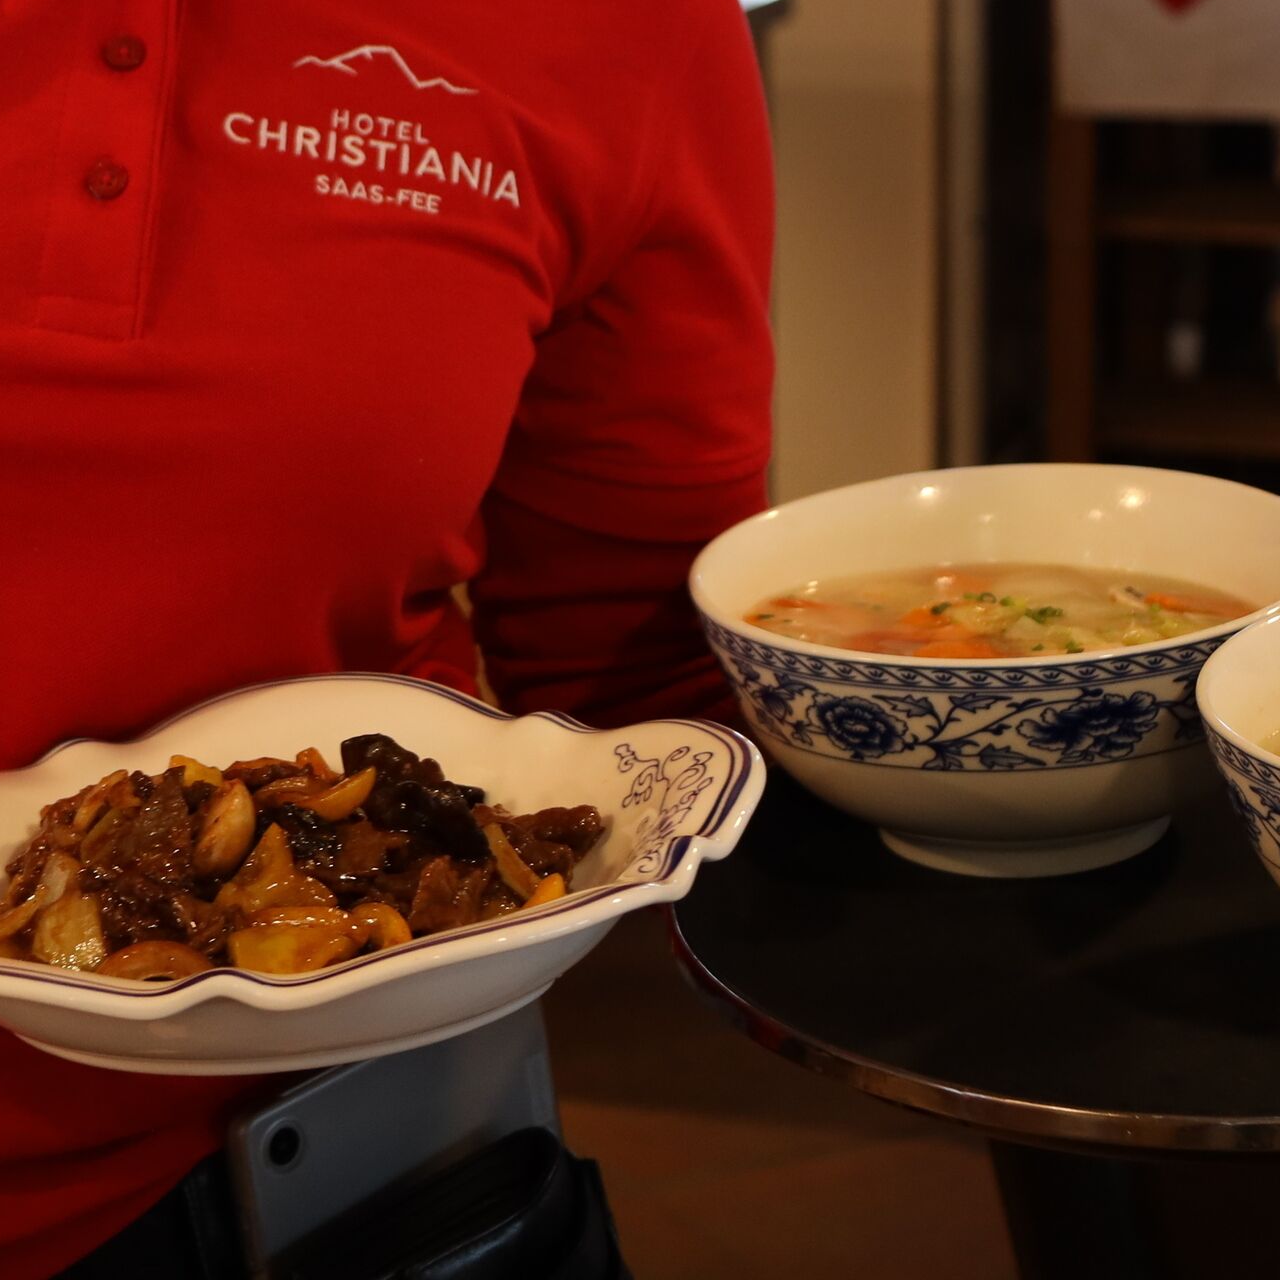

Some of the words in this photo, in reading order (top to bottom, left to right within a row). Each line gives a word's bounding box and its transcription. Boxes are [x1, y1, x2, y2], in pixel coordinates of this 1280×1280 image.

[330, 108, 429, 145] HOTEL
[222, 112, 520, 208] CHRISTIANIA
[315, 173, 441, 214] SAAS-FEE
